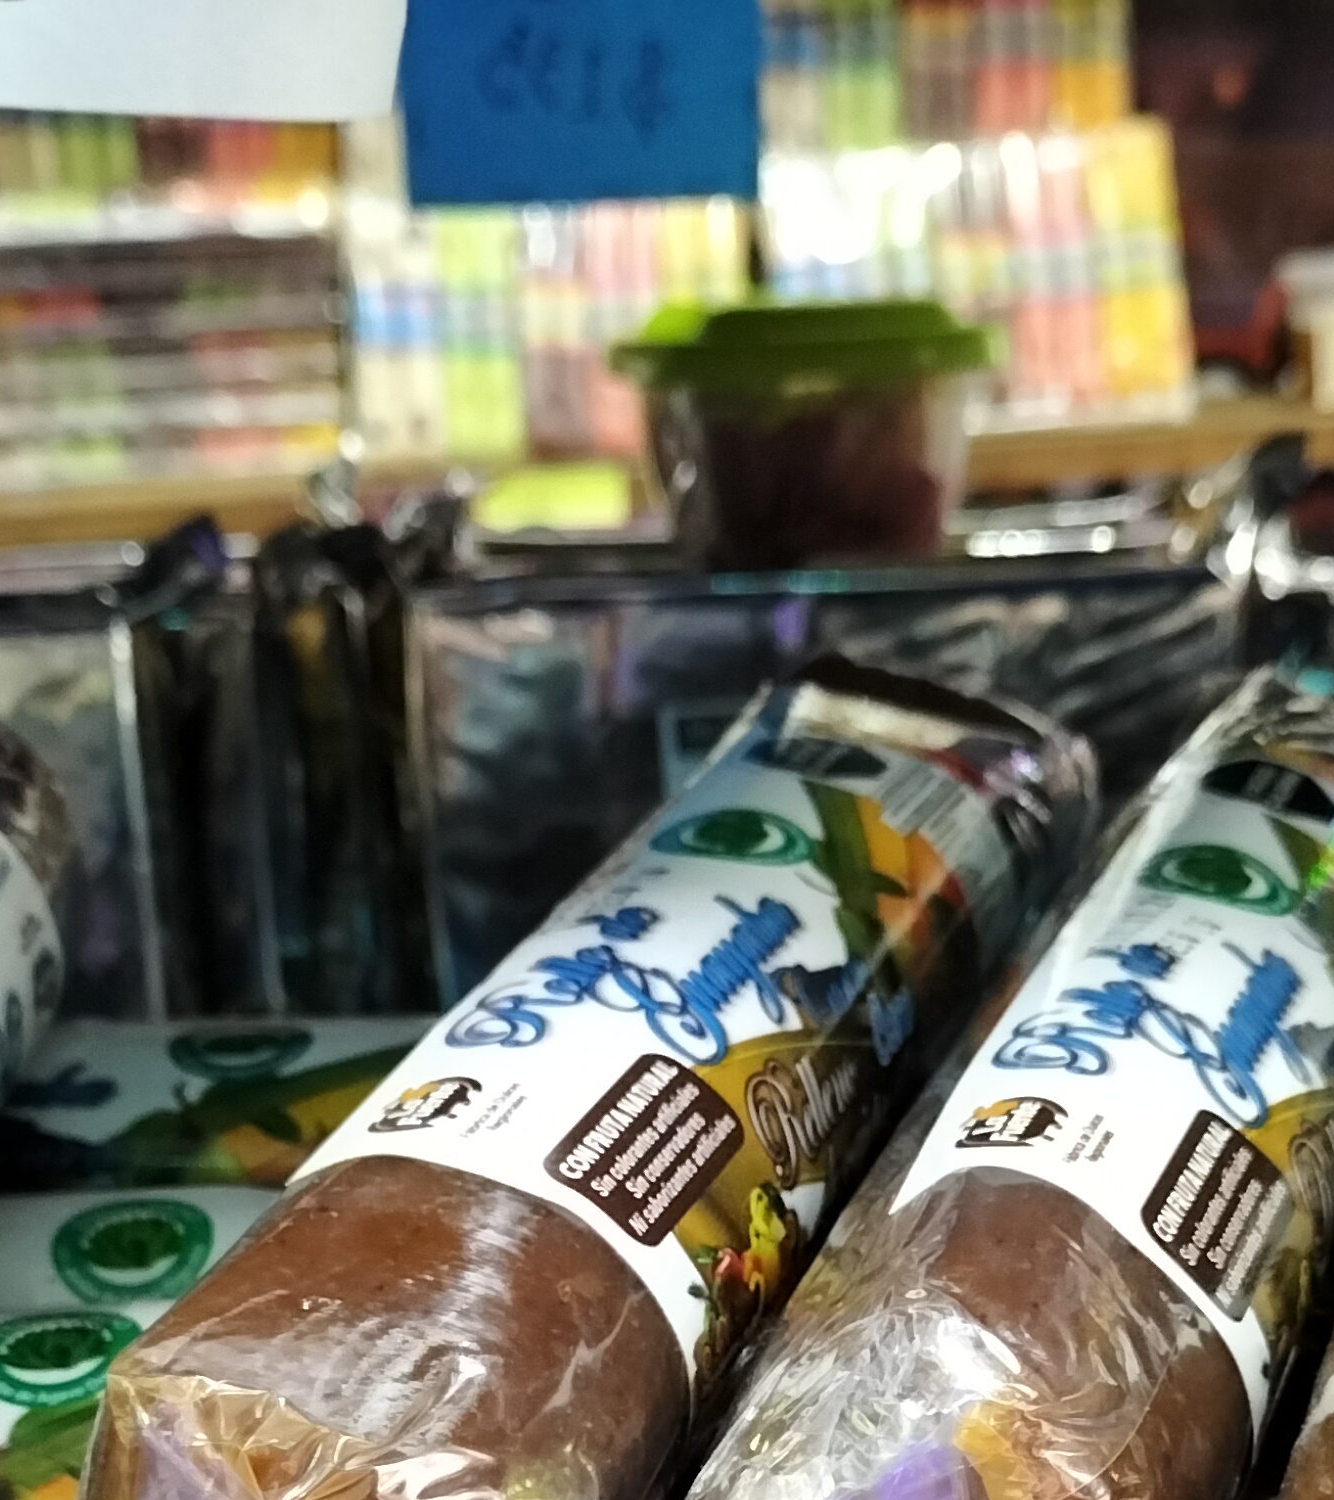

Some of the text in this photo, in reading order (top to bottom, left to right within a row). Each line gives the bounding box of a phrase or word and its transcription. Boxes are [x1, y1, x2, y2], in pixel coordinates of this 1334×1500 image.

[559, 1059, 679, 1180] CON FRUTA NATURAL
[590, 1082, 700, 1197] Sin colorantes artificiales
[625, 1111, 706, 1199] Sin conservadores
[628, 1114, 737, 1236] Ni saborizantes artificiales
[1153, 1120, 1233, 1243] CON FRUTA NATURAL
